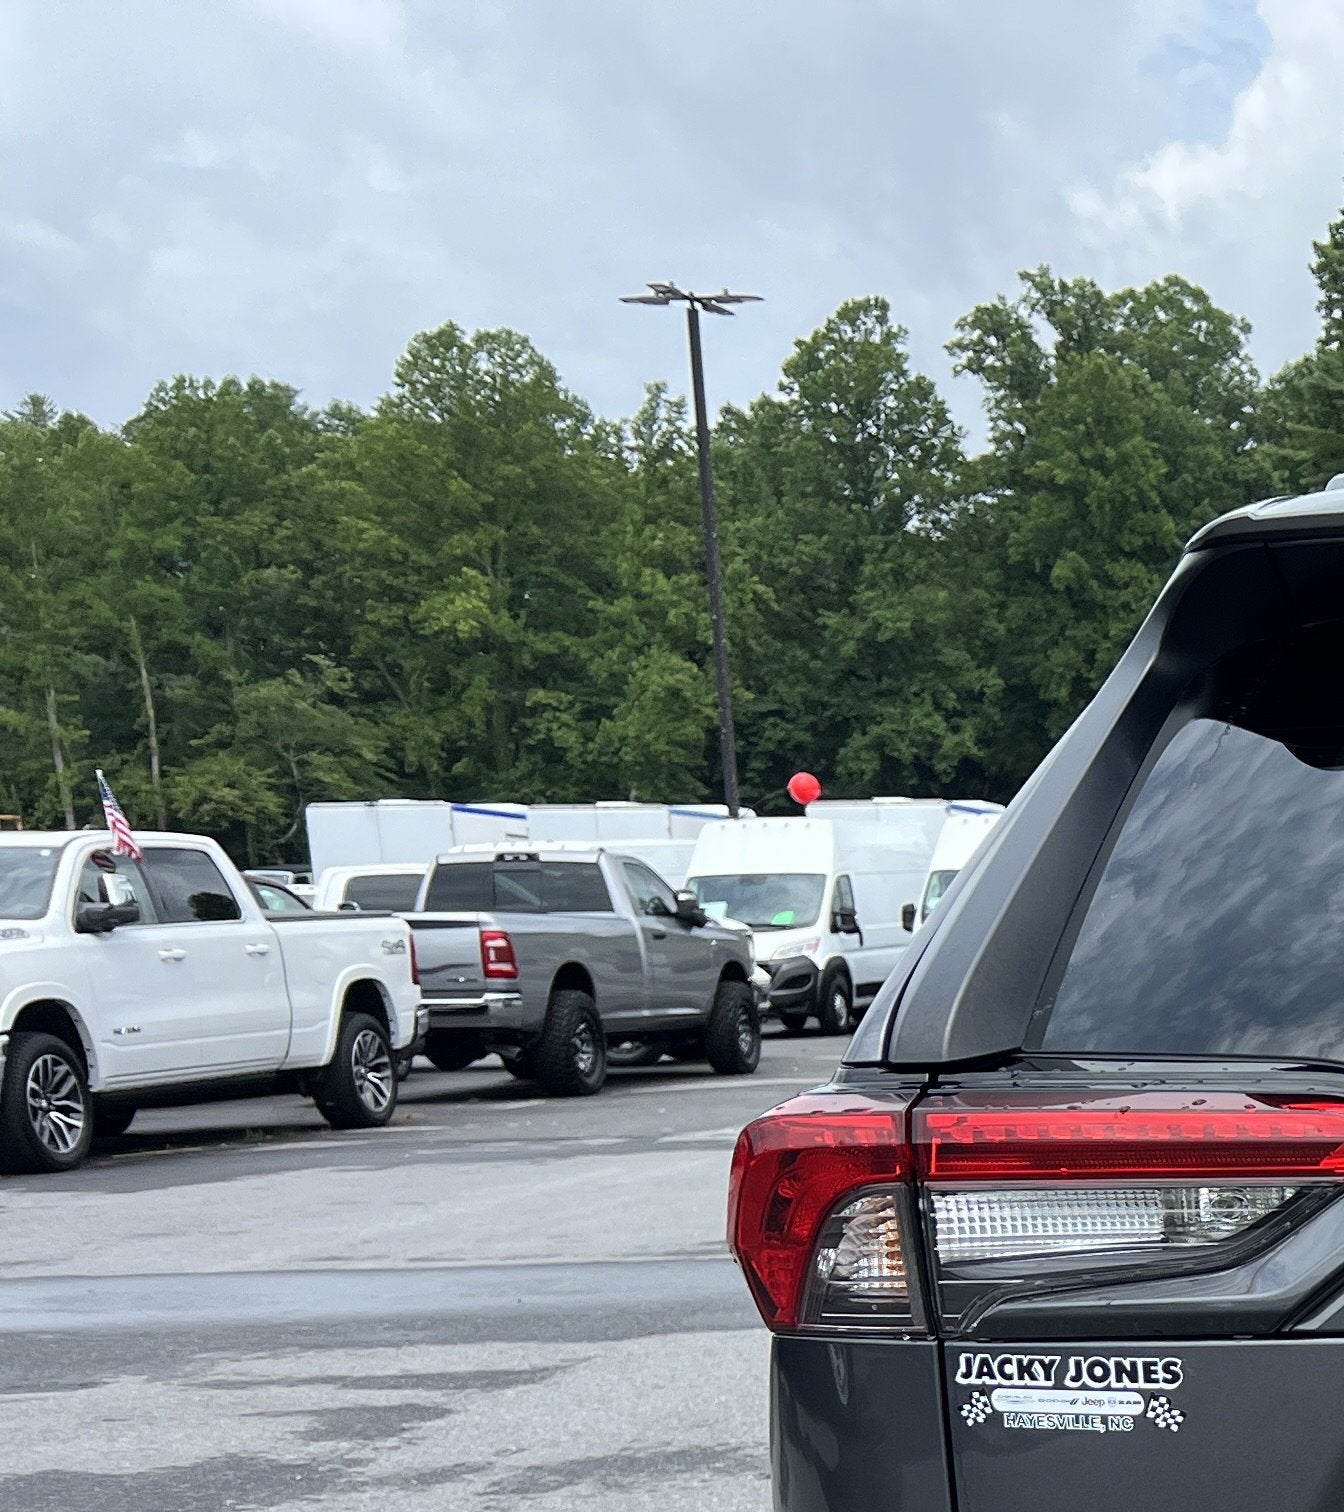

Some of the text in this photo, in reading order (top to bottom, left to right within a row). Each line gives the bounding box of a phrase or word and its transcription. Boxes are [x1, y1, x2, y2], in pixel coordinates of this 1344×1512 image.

[955, 1353, 1184, 1389] JACKY JONES
[1003, 1412, 1134, 1433] HAYESVILLE, NC
